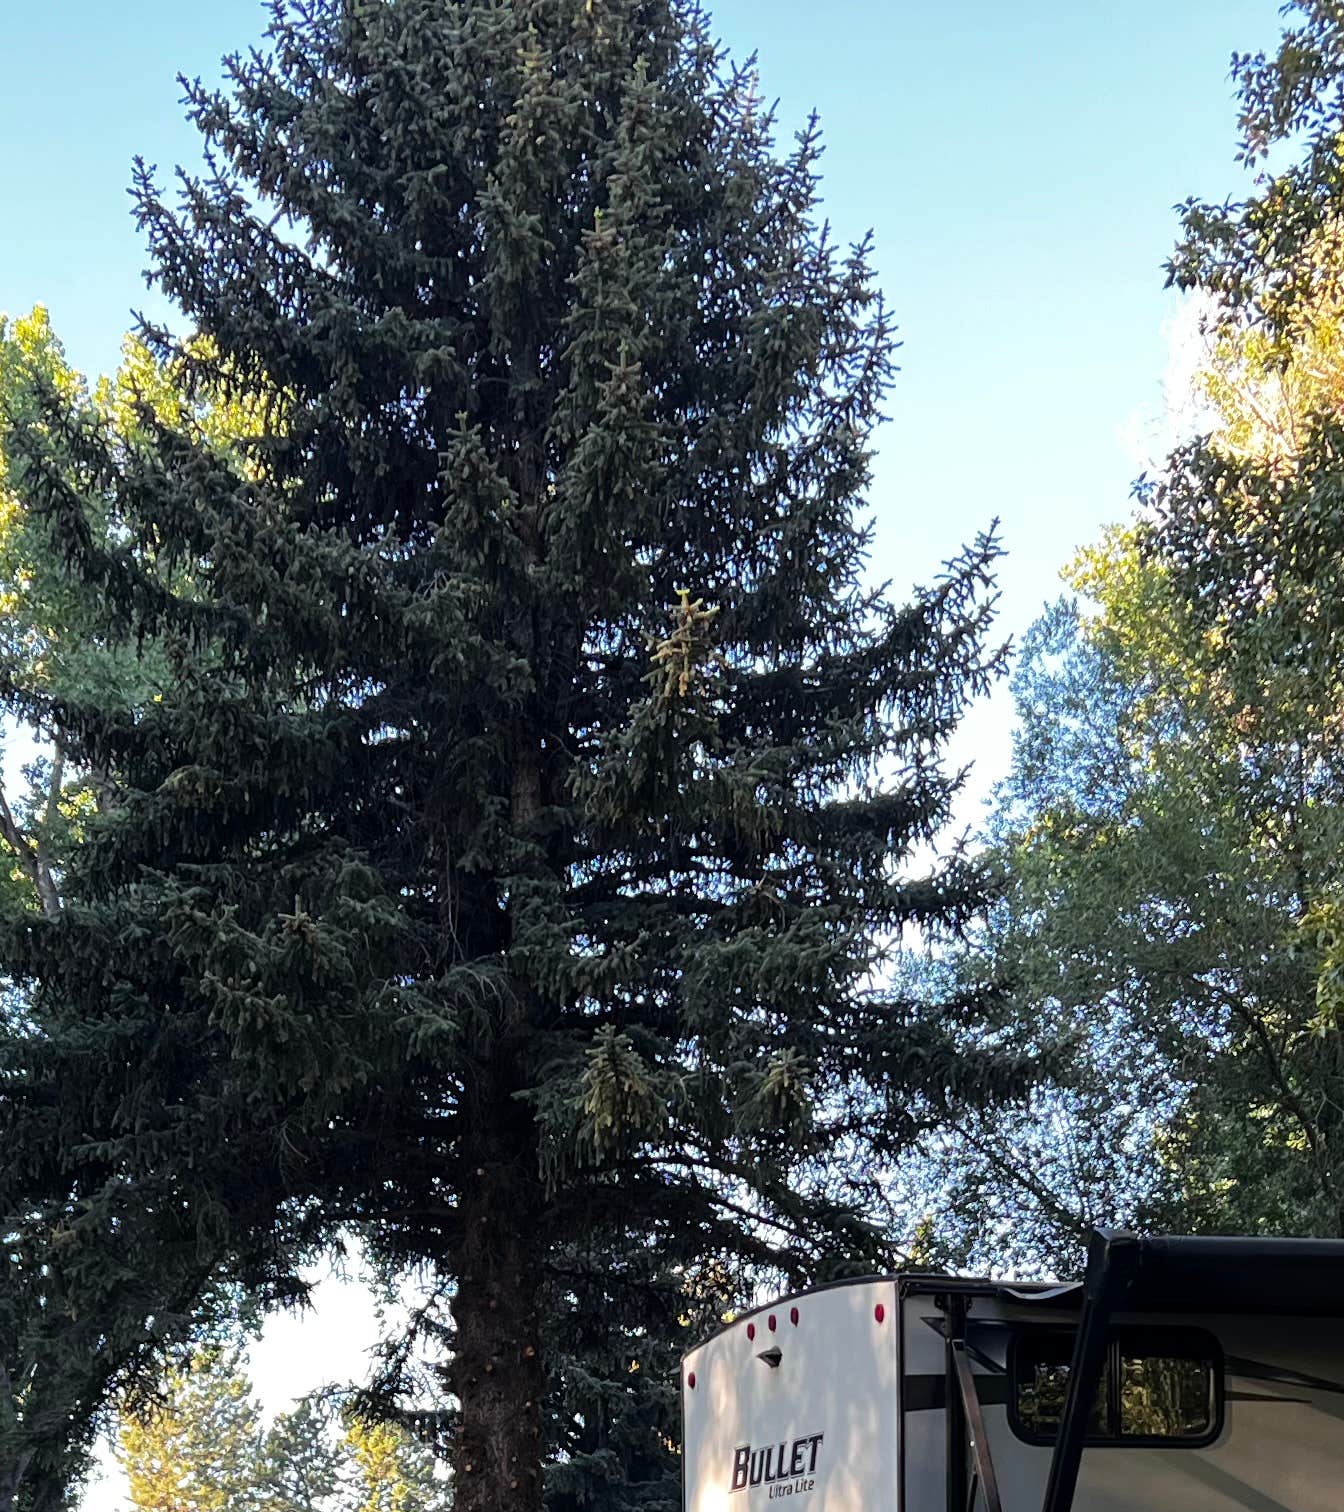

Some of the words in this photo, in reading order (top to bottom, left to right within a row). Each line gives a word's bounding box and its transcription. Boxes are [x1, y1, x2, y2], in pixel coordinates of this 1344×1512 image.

[728, 1431, 825, 1494] BULLET
[768, 1483, 793, 1500] Ultra
[795, 1479, 815, 1494] Lite
